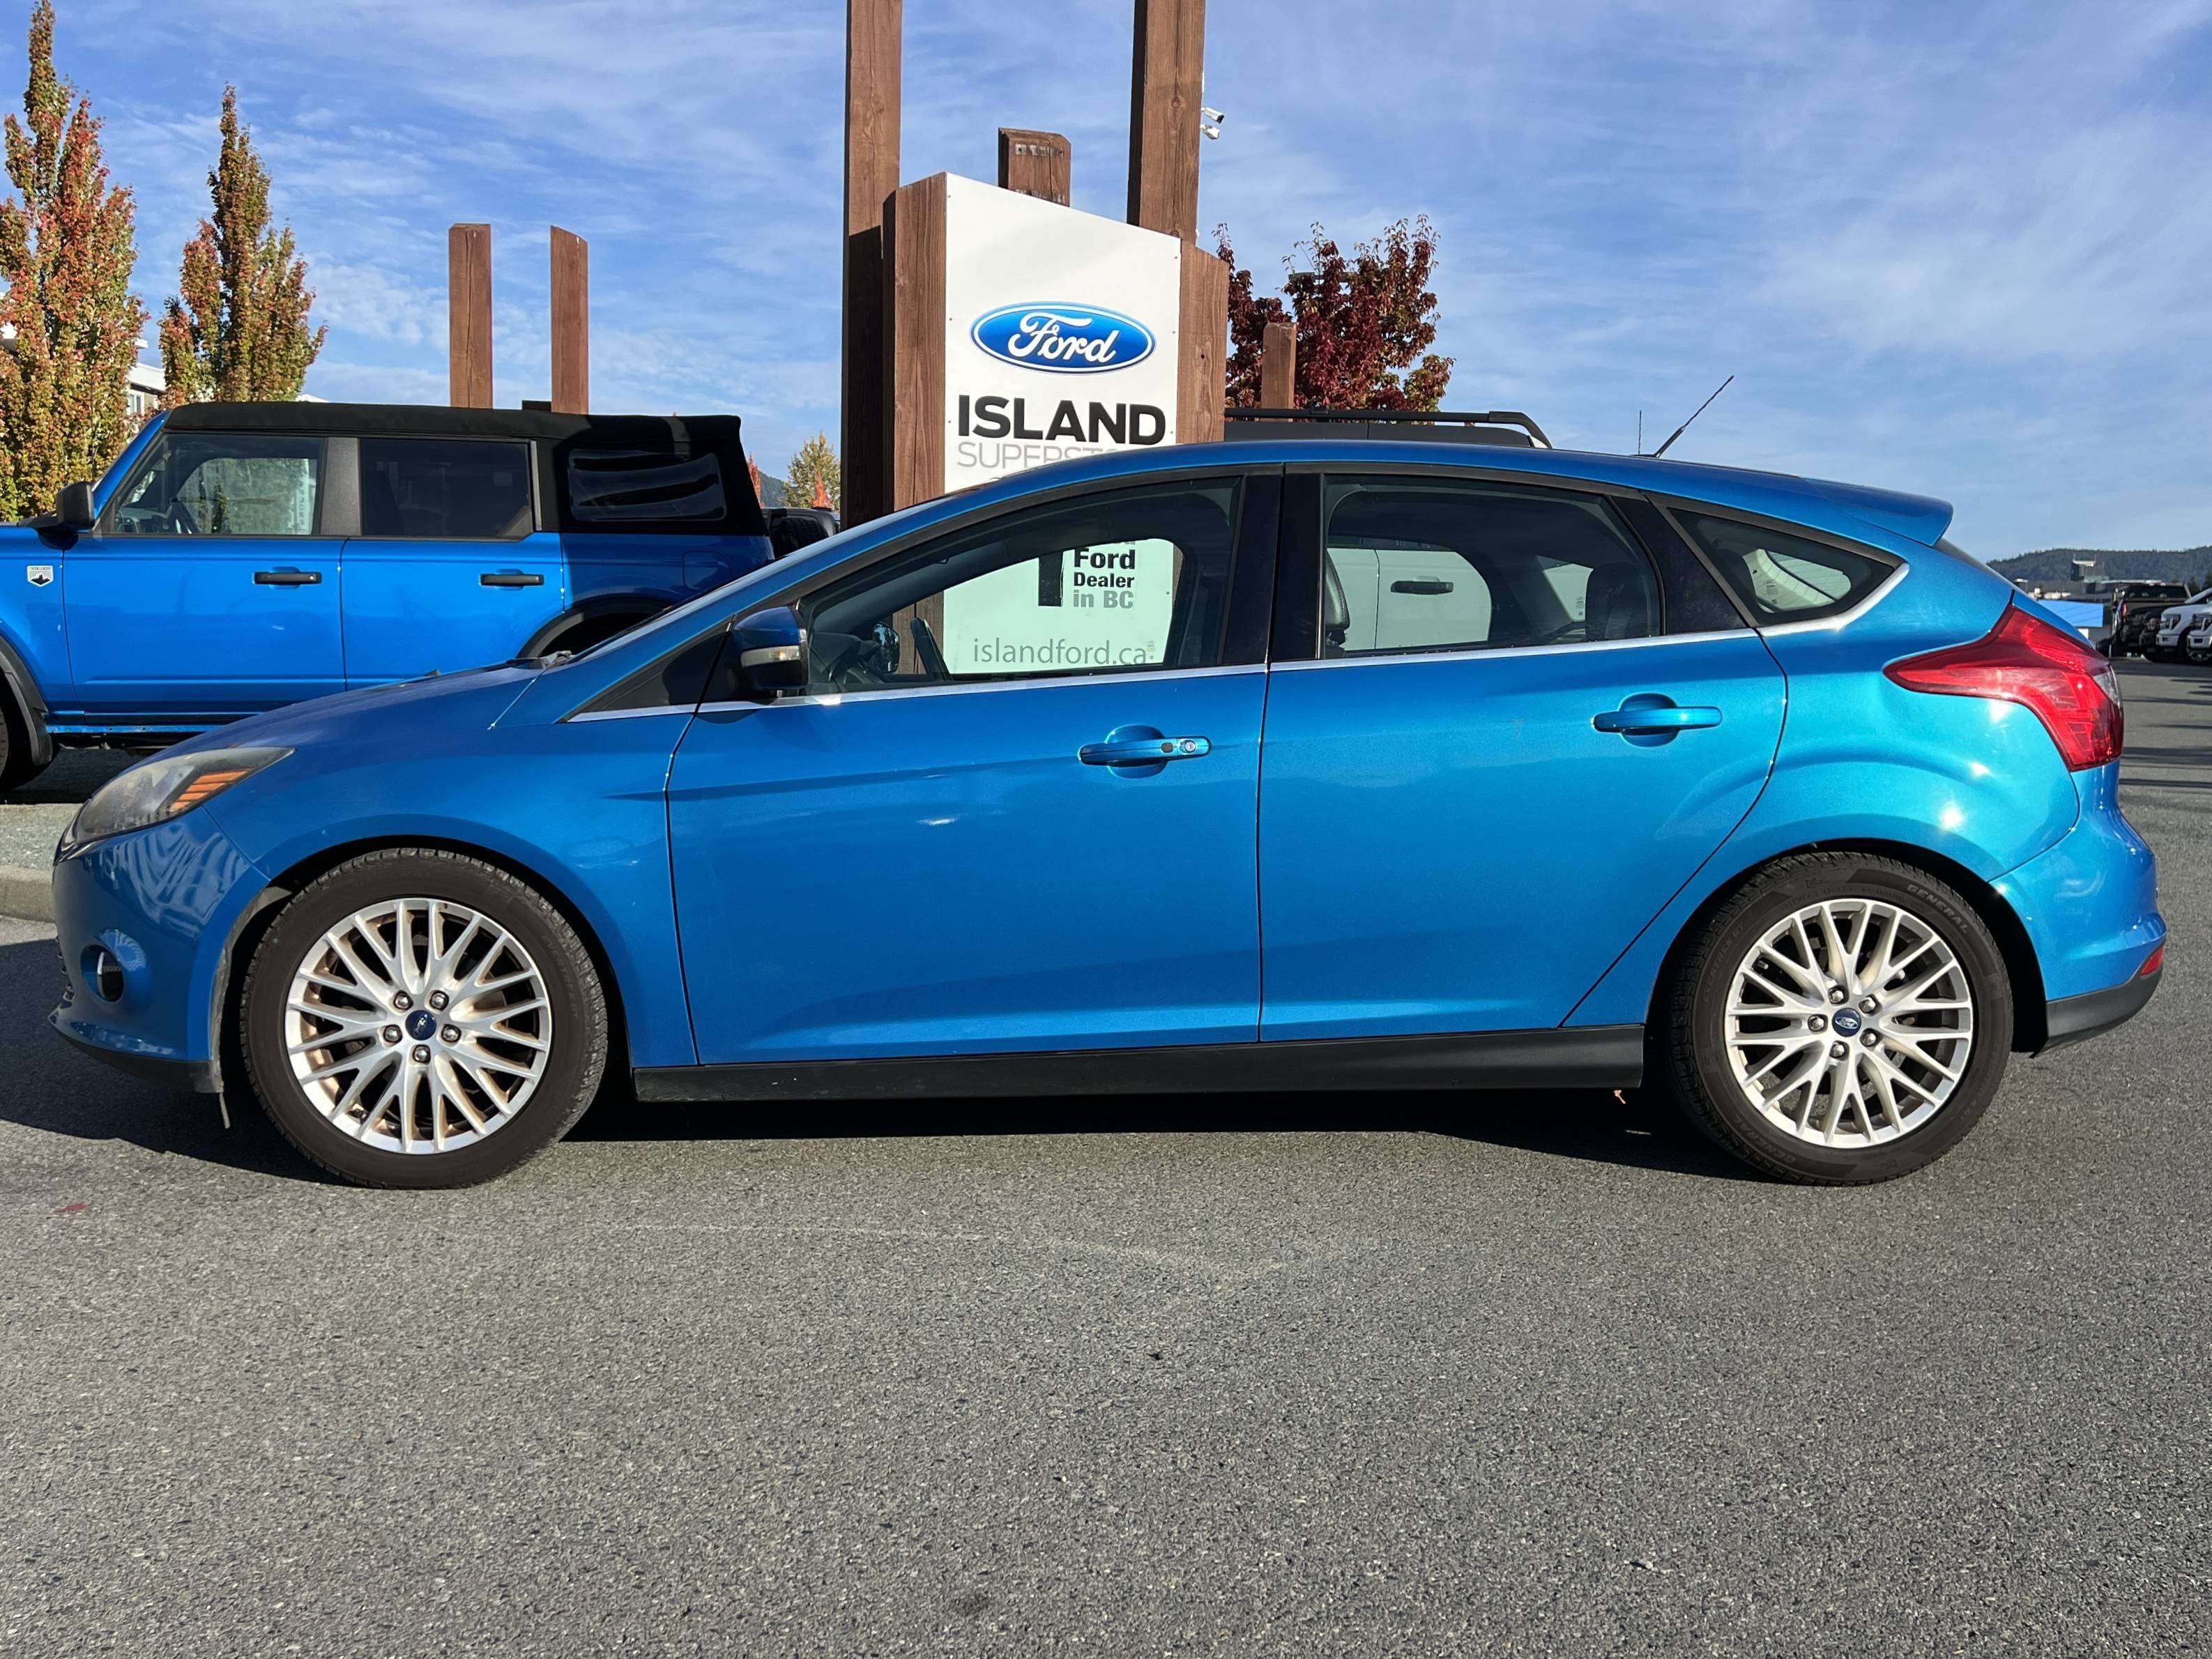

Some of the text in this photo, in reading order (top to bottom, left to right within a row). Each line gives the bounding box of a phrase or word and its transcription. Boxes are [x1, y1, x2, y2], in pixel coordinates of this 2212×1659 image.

[1007, 312, 1120, 363] Ford
[958, 394, 1166, 446] ISLAND
[957, 441, 1120, 469] SUPERS
[1074, 547, 1136, 570] Ford
[1074, 572, 1135, 588] Dealer
[1073, 589, 1134, 609] in BC
[973, 636, 1146, 665] islandford.ca
[1906, 883, 1969, 934] GENERAL
